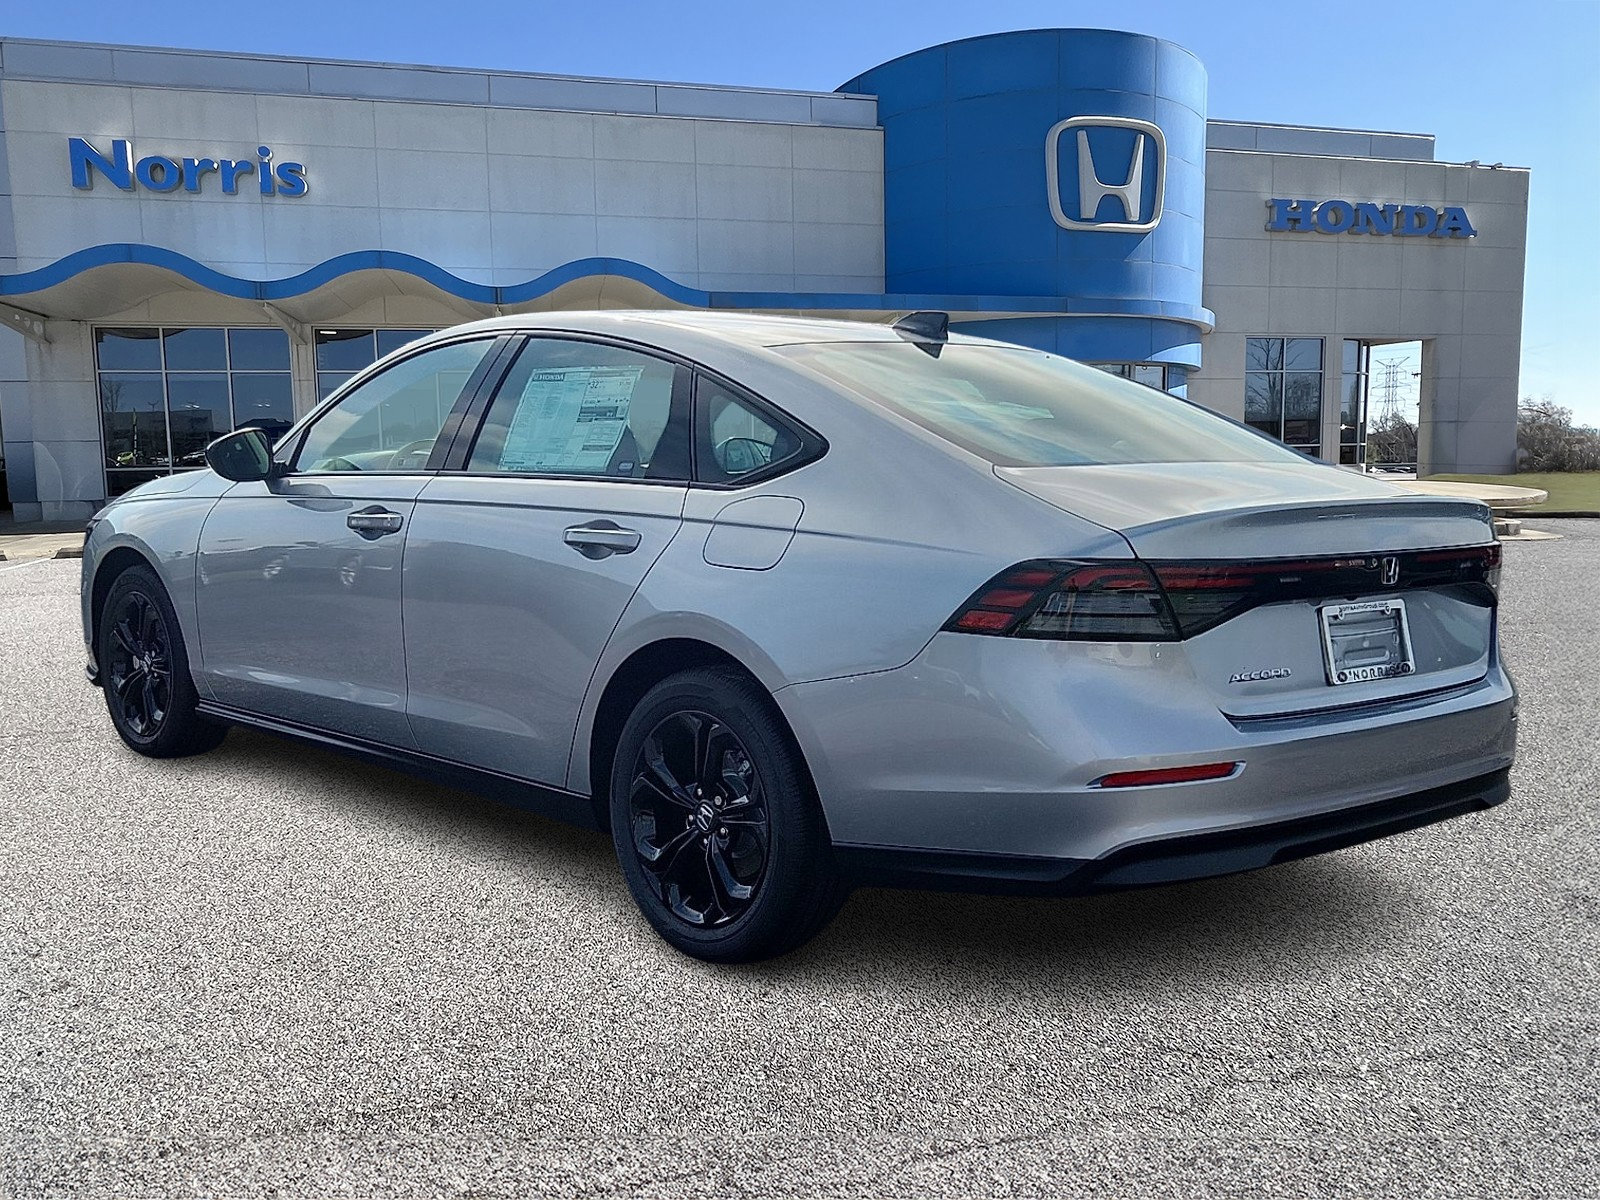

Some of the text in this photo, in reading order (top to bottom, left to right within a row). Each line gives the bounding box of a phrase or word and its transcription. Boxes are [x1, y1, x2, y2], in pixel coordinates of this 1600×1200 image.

[68, 137, 308, 197] Norris
[1265, 198, 1478, 239] HONDA
[539, 372, 564, 381] HONDA
[1229, 667, 1291, 683] ACCORD
